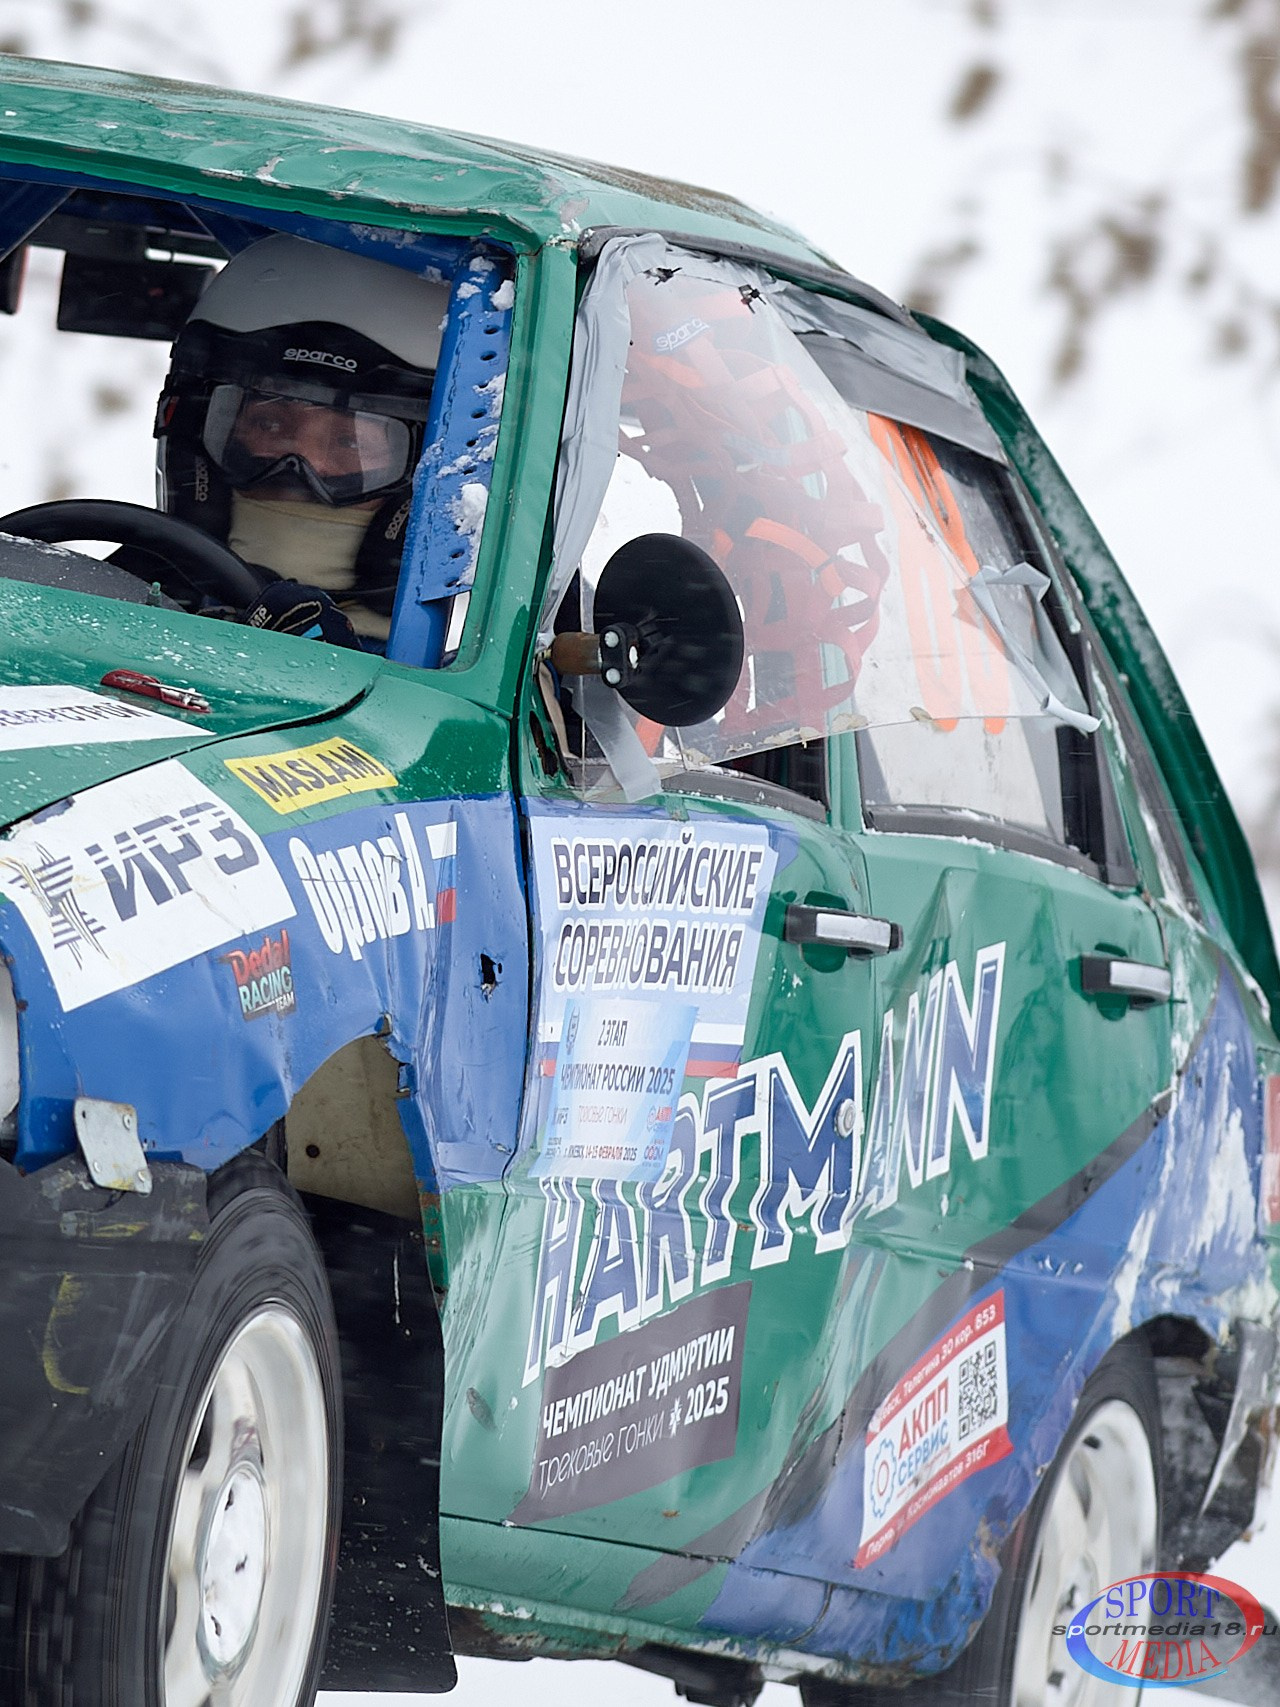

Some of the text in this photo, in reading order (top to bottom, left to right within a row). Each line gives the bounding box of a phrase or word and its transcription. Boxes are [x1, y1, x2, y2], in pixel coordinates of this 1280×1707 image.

[283, 348, 357, 372] sparco
[237, 744, 386, 803] MASLAMI
[84, 801, 260, 922] ИРЗ
[552, 832, 763, 911] ВСЕРОССИЙСКИЕ
[554, 922, 744, 988] СОРЕВНОВАНИЯ
[238, 965, 293, 1014] RACING
[275, 991, 295, 1012] TEAM
[604, 1020, 628, 1047] ЭТАП
[560, 1063, 676, 1095] ЧЕМПИОНАТ РОССИИ 2025
[522, 941, 1006, 1388] HARTMANN
[941, 1338, 954, 1361] 30
[975, 1304, 997, 1331] 853
[543, 1325, 736, 1439] ЧЕМПИОНАТ УДМУРТИИ
[684, 1375, 730, 1425] 2025
[898, 1376, 950, 1460] АКПП
[897, 1418, 949, 1487] СЕРВИС
